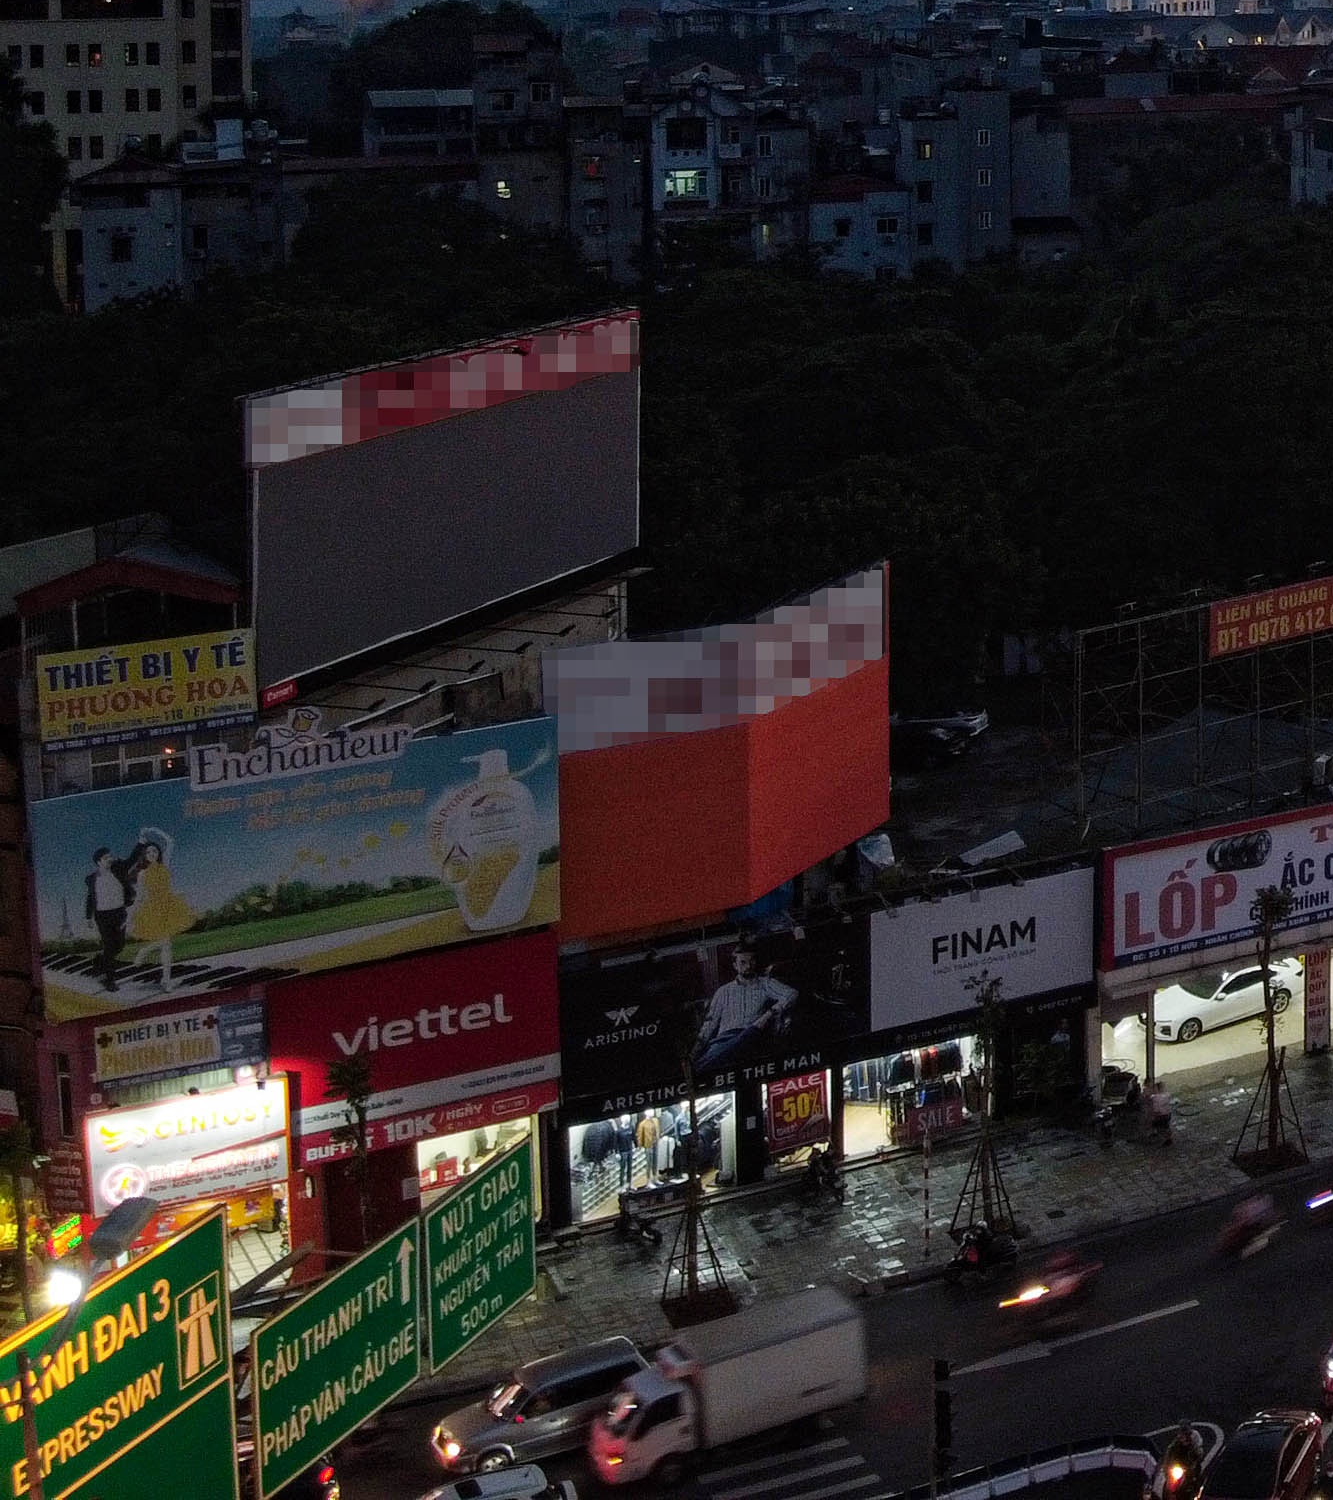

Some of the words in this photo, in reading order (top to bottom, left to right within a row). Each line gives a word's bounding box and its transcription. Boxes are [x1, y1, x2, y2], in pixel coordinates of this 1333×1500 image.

[1278, 585, 1328, 609] QUẢNG
[1249, 614, 1290, 645] 0978
[1294, 604, 1325, 633] 412
[45, 650, 130, 692] THIẾT
[141, 651, 173, 683] BỊ
[183, 647, 200, 673] Y
[48, 684, 176, 722] PHƯƠNG
[198, 726, 412, 786] Enchanteur
[1280, 851, 1314, 892] ẮC
[1125, 858, 1237, 949] LỐP
[932, 916, 1036, 965] FINAM
[332, 993, 513, 1056] viettel
[584, 1022, 657, 1050] ARISTINO
[602, 1081, 689, 1113] ARISTINO
[714, 1071, 736, 1088] BE
[743, 1062, 776, 1081] THE
[783, 1051, 822, 1072] MAN
[770, 1073, 822, 1097] SALE
[384, 1111, 437, 1143] 10K
[775, 1088, 821, 1124] -50%
[918, 1105, 954, 1132] SALE
[441, 1194, 475, 1245] NÚT
[480, 1160, 520, 1212] GIAO
[434, 1232, 474, 1289] KHUẤT
[473, 1219, 498, 1256] DUY
[93, 1291, 148, 1363] ĐAI
[152, 1278, 171, 1323] 3
[261, 1335, 299, 1391] CẦU
[302, 1295, 363, 1362] THANH
[366, 1260, 393, 1314] TRÌ
[460, 1303, 489, 1337] 500
[490, 1293, 503, 1310] m
[12, 1361, 165, 1498] EPRESSWAY
[262, 1403, 311, 1467] PHÁP
